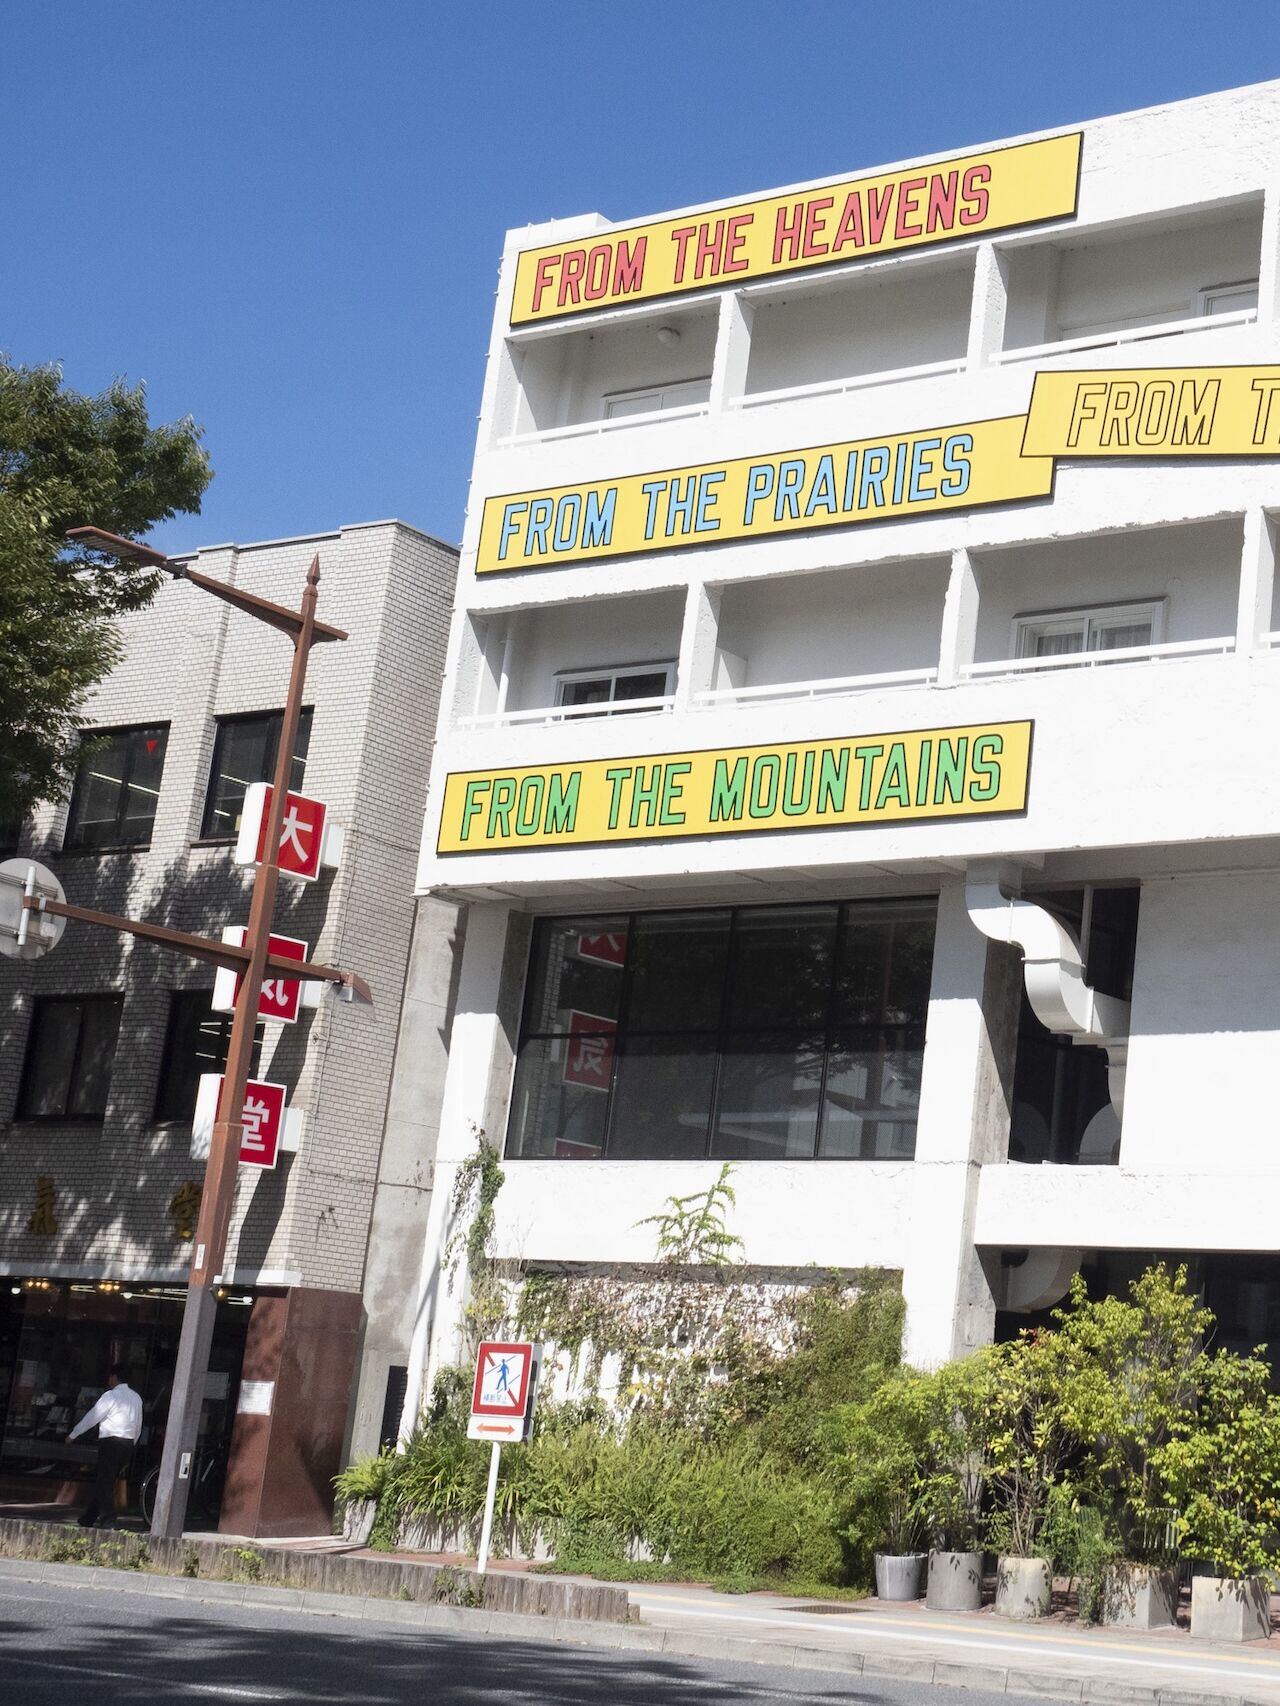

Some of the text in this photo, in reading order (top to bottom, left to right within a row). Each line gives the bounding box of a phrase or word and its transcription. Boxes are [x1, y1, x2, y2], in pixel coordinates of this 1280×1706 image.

[531, 164, 992, 313] FROM THE HEAVENS
[1066, 379, 1221, 447] FROM
[498, 433, 974, 561] FROM THE PRAIRIES
[460, 734, 1004, 842] FROM THE MOUNTAINS
